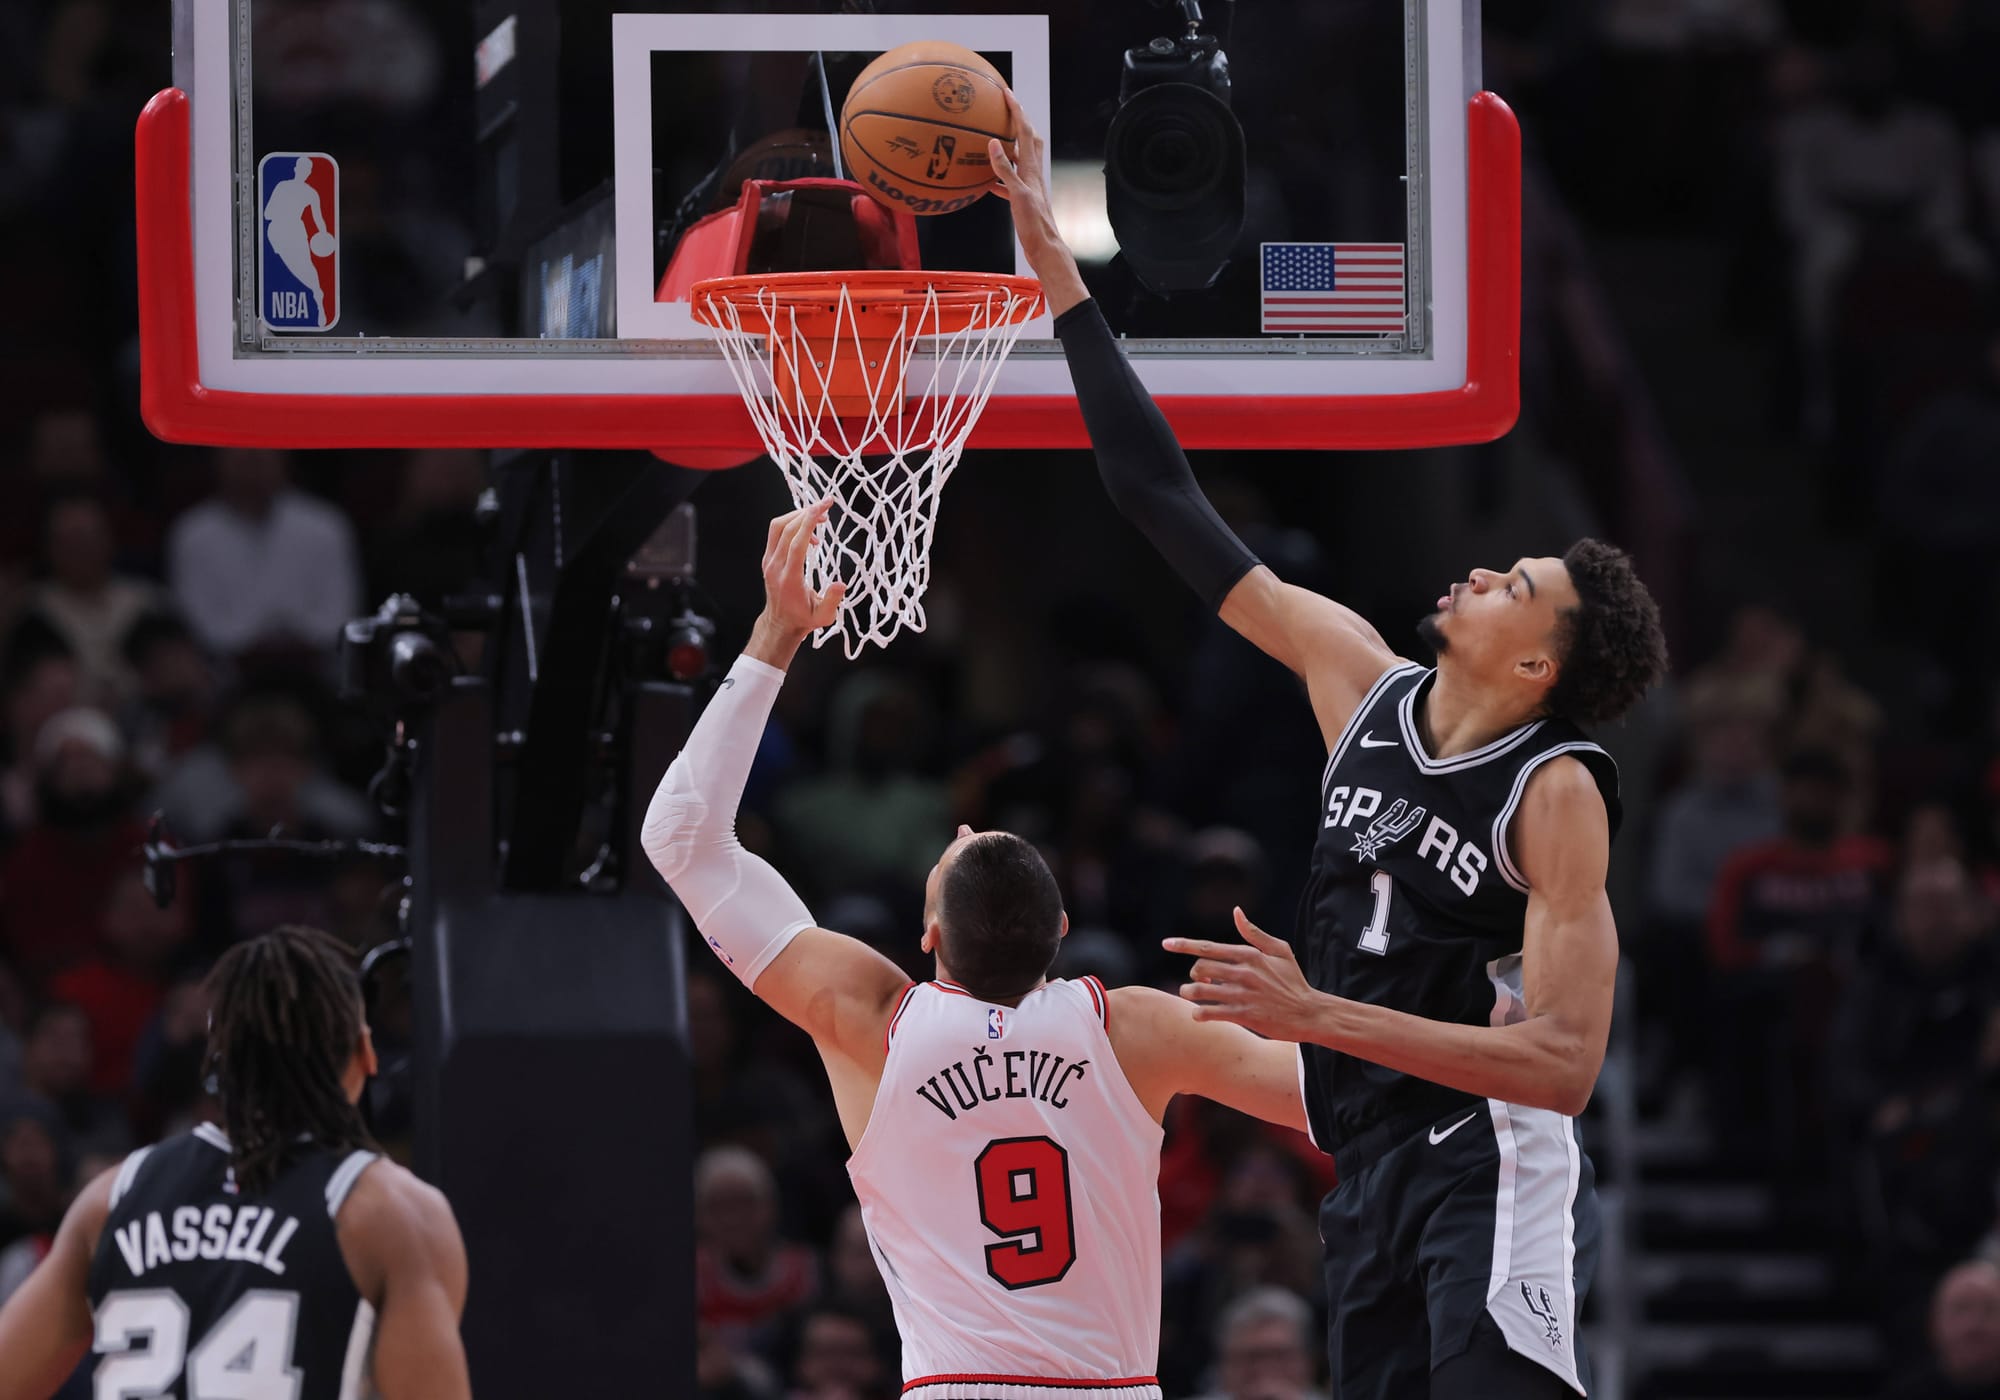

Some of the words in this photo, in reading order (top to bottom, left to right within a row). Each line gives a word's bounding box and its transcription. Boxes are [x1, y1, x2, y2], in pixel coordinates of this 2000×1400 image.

[868, 170, 976, 213] Wilson
[272, 291, 309, 319] NBA
[1324, 786, 1488, 897] SPURS
[1357, 869, 1393, 956] 1
[916, 1045, 1092, 1121] VUČEVIĆ
[114, 1203, 299, 1277] VASSELL
[974, 1135, 1077, 1291] 9
[92, 1287, 304, 1400] 24
